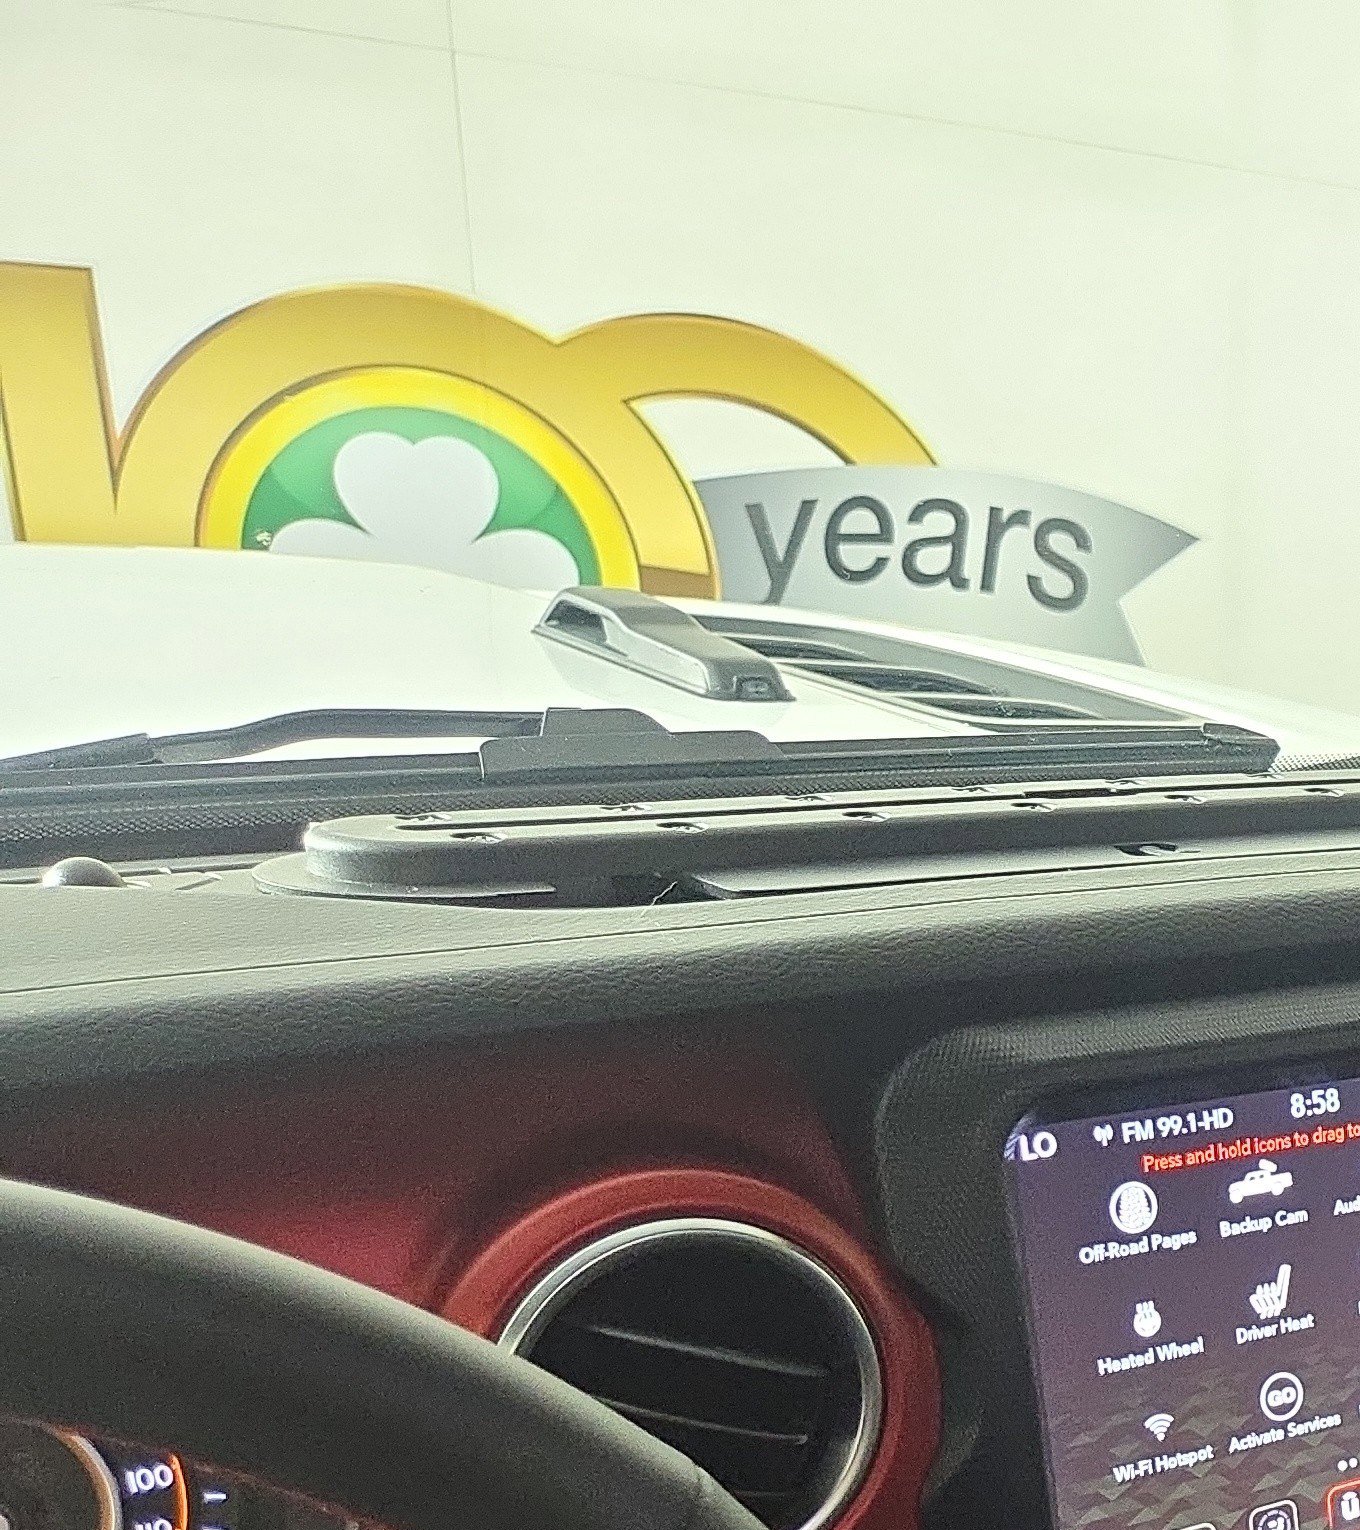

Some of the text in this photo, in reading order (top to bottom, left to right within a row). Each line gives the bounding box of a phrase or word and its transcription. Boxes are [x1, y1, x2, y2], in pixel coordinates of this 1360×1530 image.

[744, 492, 1093, 614] years
[1290, 1088, 1341, 1118] 8:58
[1121, 1107, 1235, 1144] FM 99.1-HD
[1019, 1130, 1058, 1162] LO
[1142, 1153, 1183, 1173] Press
[1186, 1144, 1215, 1164] and
[1218, 1138, 1252, 1160] hold
[1255, 1134, 1292, 1155] icons
[1293, 1131, 1309, 1149] to
[1312, 1123, 1345, 1146] drag
[1219, 1208, 1309, 1238] Backup Cam
[1078, 1230, 1198, 1264] Off-Road Pages
[1235, 1313, 1316, 1345] Driver Heat
[1097, 1335, 1205, 1376] Heated Wheel
[1228, 1412, 1342, 1455] Activate Services
[125, 1465, 174, 1495] 100
[1112, 1443, 1215, 1484] Wi-Fi Hotspot
